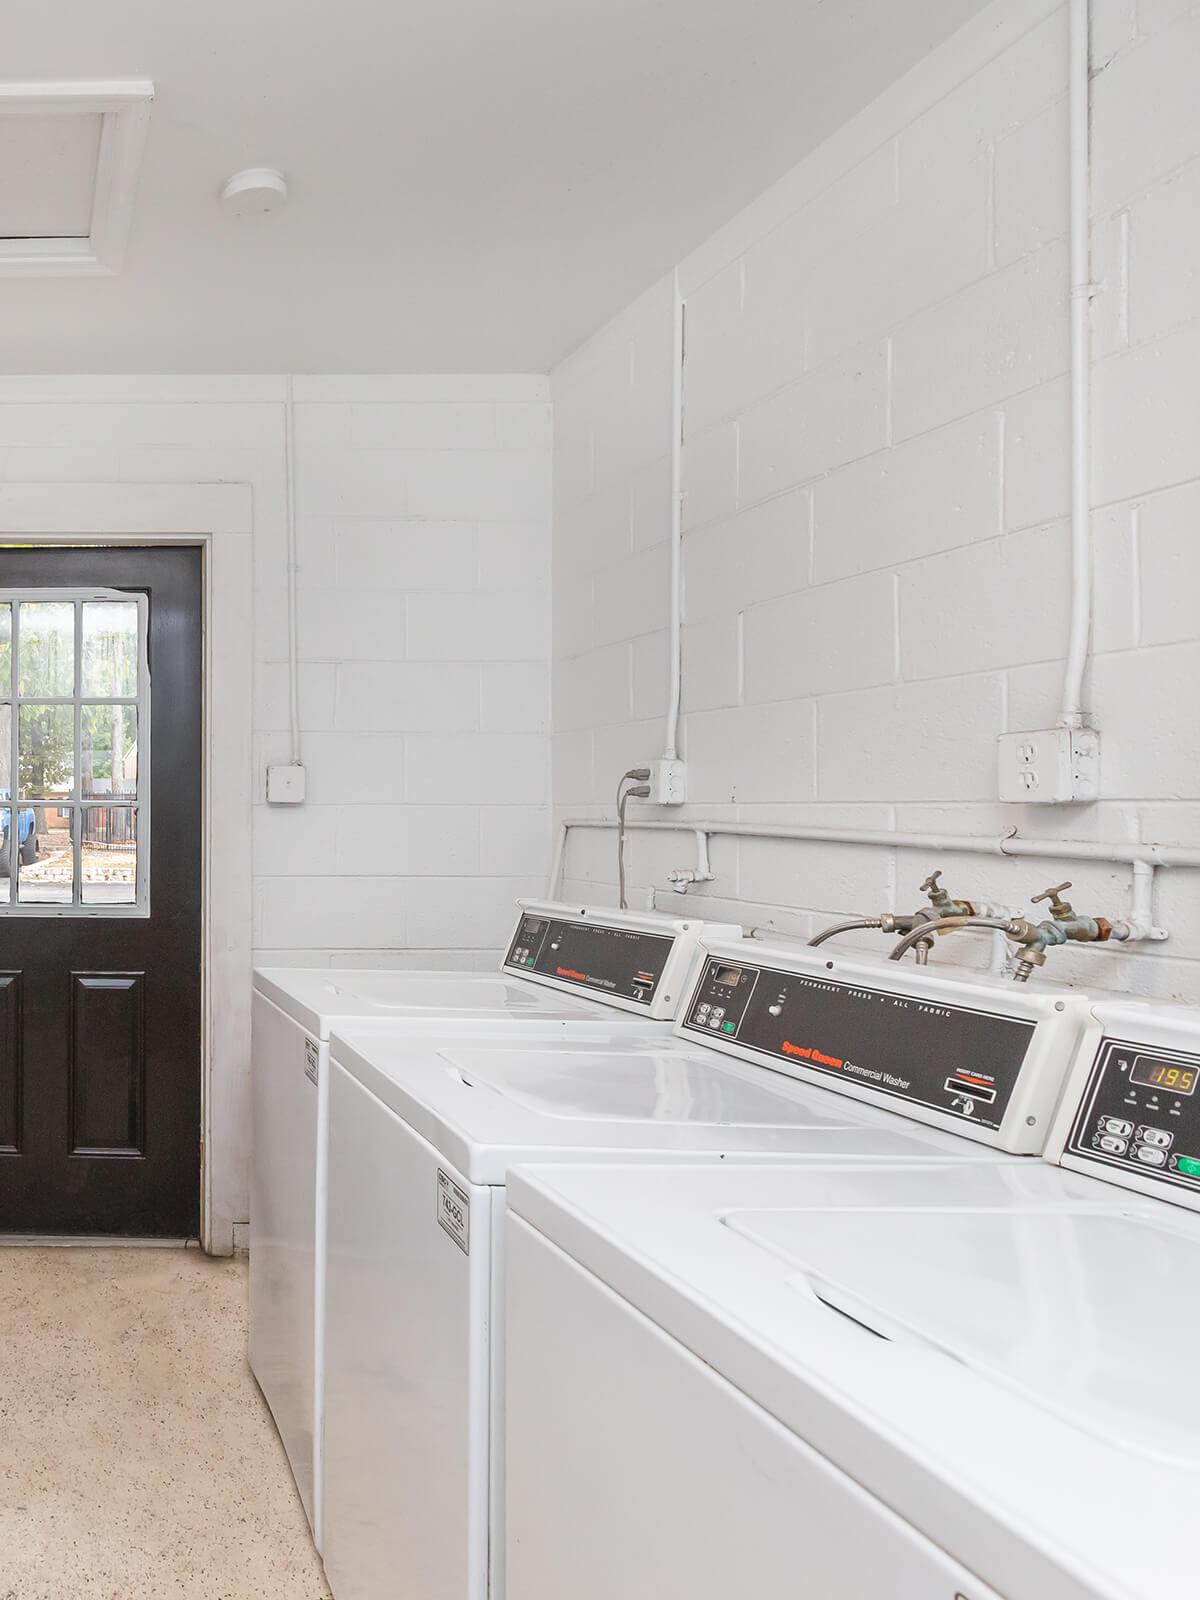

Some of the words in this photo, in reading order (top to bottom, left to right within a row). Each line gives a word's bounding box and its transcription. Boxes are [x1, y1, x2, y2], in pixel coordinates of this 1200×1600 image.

[800, 980, 841, 993] PERMANENT
[847, 989, 872, 1000] PRESS
[893, 1000, 909, 1008] ALL
[918, 1005, 951, 1017] FABRIC
[782, 1041, 813, 1058] Speed
[811, 1048, 843, 1069] Queen
[843, 1060, 883, 1081] Commercial
[882, 1072, 911, 1090] Washer
[1156, 1067, 1194, 1090] 195
